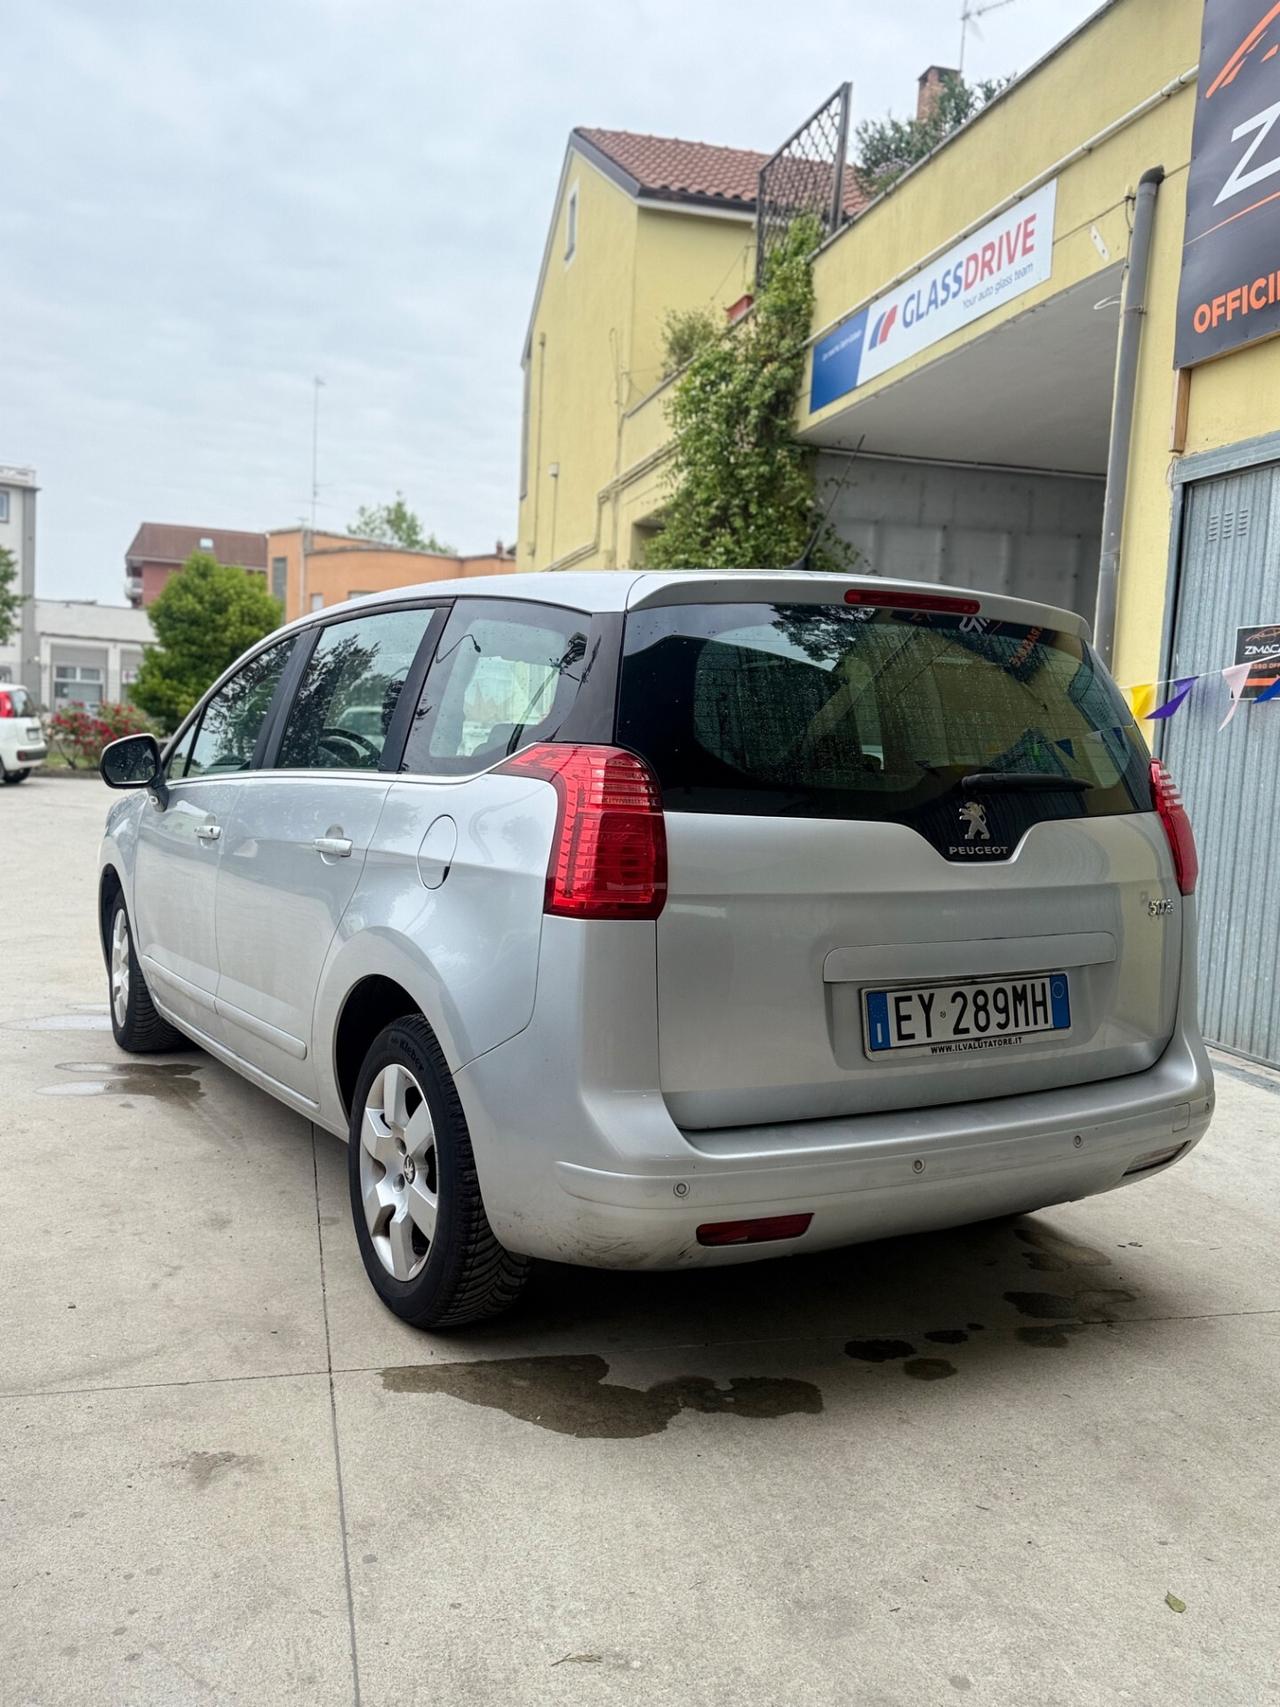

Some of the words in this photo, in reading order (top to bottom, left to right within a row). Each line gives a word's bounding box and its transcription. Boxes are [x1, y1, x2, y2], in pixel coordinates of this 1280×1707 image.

[902, 213, 1037, 329] GLASSDRIVE
[978, 286, 993, 301] auto
[995, 274, 1012, 295] glass
[1014, 263, 1034, 281] team
[949, 846, 1008, 855] PEUGEOT
[894, 992, 935, 1041] EY
[951, 982, 1048, 1035] 289MH
[930, 1037, 1023, 1054] WWW.ILVALUTATORE.IT
